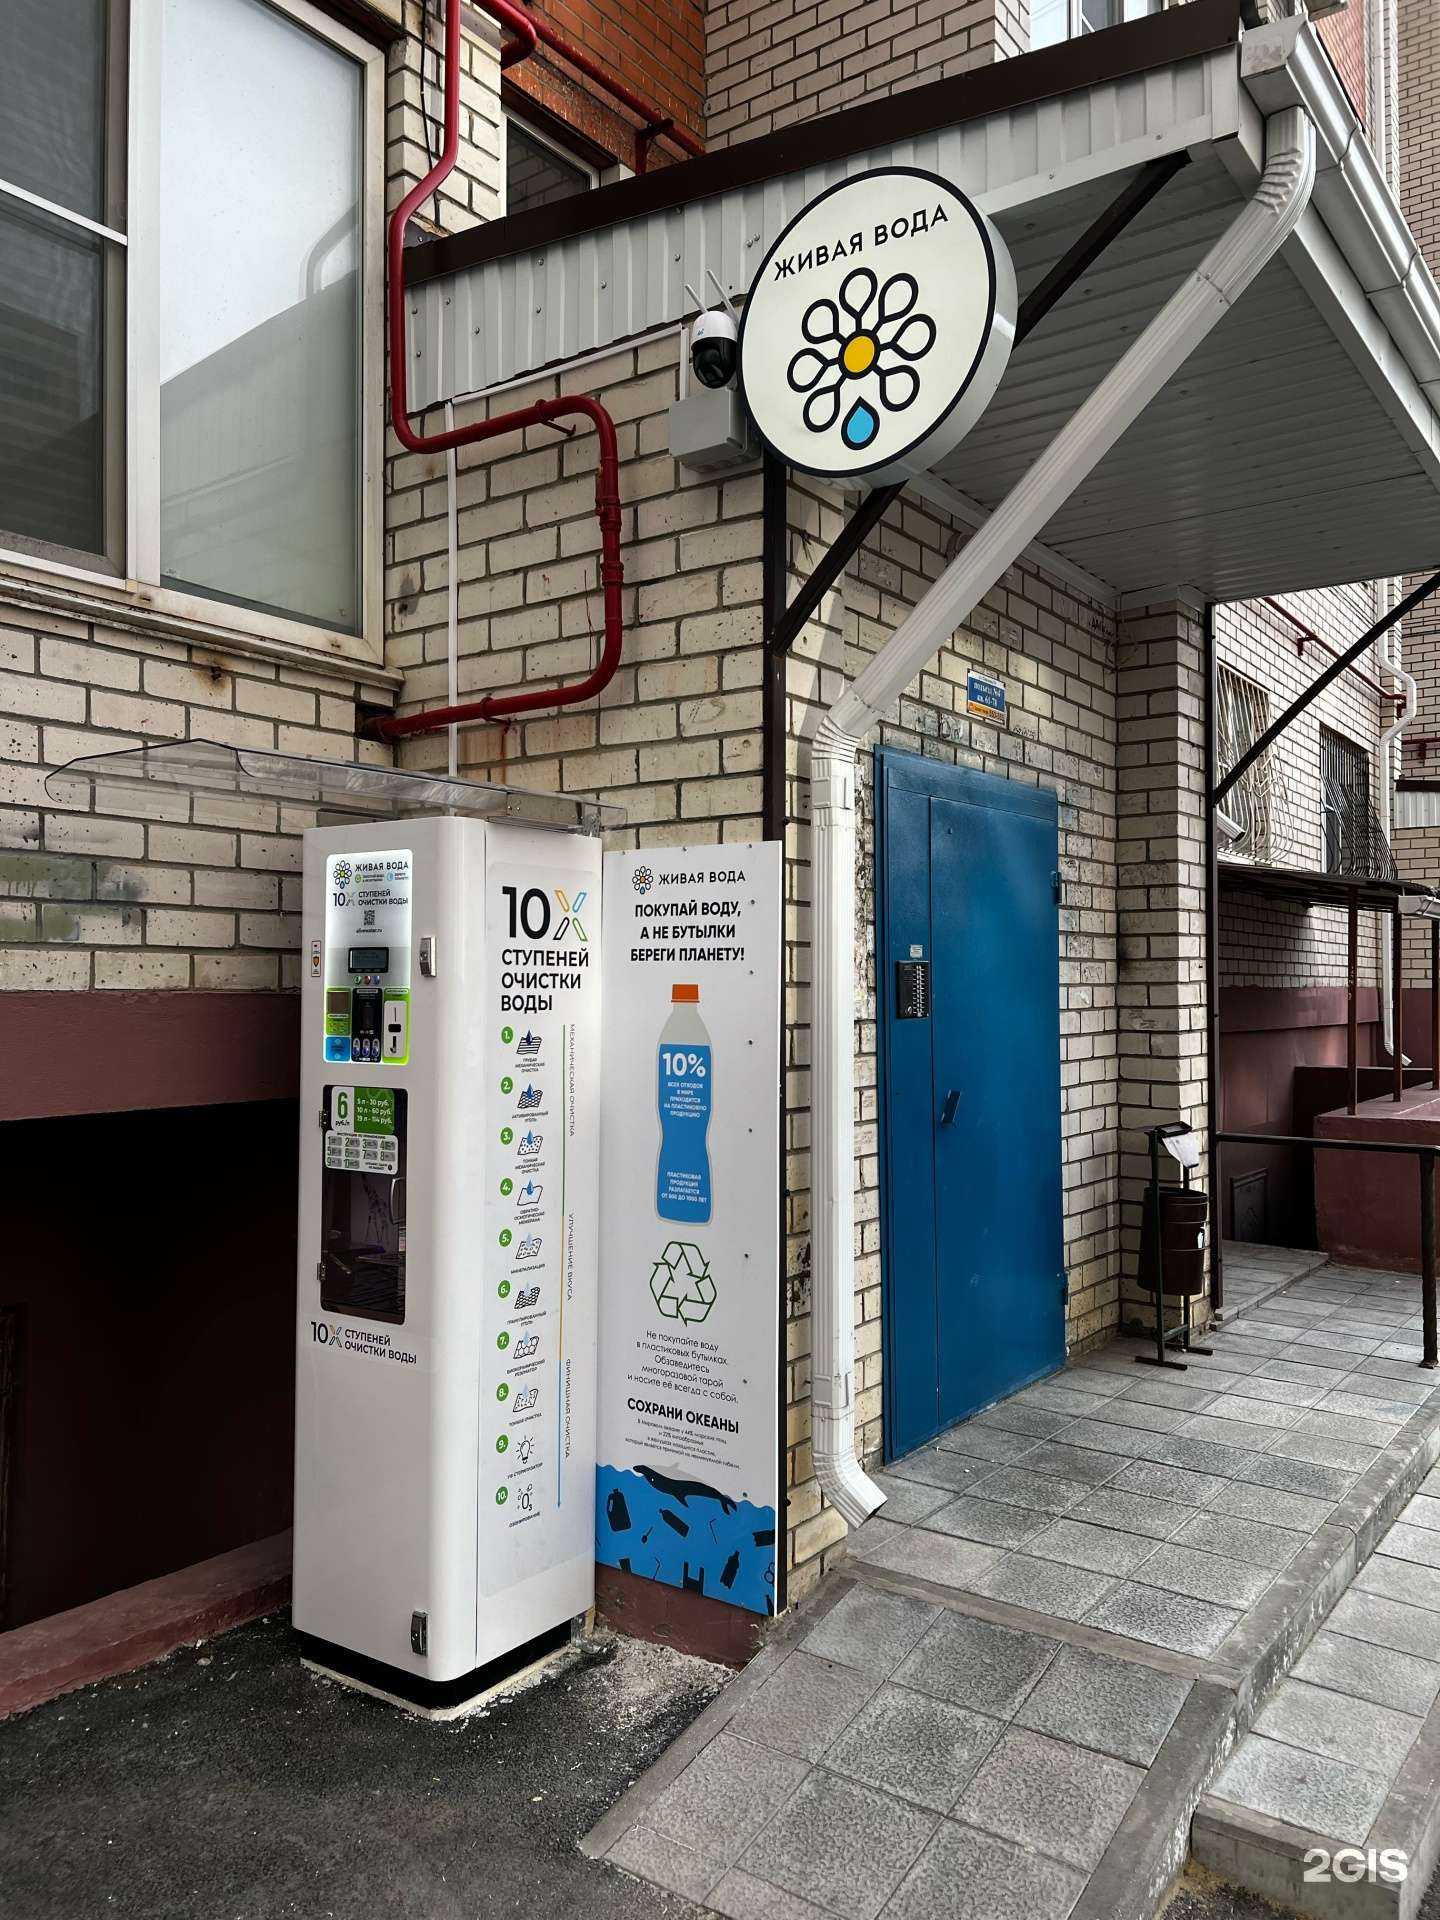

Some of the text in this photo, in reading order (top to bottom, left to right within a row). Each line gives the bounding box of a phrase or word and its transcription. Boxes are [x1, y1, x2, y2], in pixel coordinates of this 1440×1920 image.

[774, 204, 948, 281] ЖИВАЯ ВОДА
[355, 861, 409, 872] ЖИВАЯ ВОДА
[659, 870, 746, 885] ЖИВАЯ ВОДА
[358, 889, 391, 898] СТУПЕНЕЙ
[358, 897, 408, 906] ОЧИСТКИ ВОДЫ
[635, 899, 741, 917] ПОКУПАЙ ВОДУ,
[640, 924, 735, 939] А НЕ БУТЫЛКИ
[502, 947, 589, 967] СТУПЕНЕЙ
[631, 948, 744, 962] БЕРЕГИ ПЛАНЕТУ!
[501, 972, 581, 989] ОЧИСТКИ
[501, 994, 552, 1014] ВОДЫ
[662, 1053, 706, 1077] 10%
[337, 1092, 348, 1119] 6
[345, 1329, 391, 1347] СТУПЕНЕЙ
[646, 1331, 719, 1353] Не покупайте воду
[344, 1340, 417, 1364] ОЧИСТКИ ВОДЫ
[642, 1342, 690, 1357] пластиковых
[654, 1354, 710, 1374] Обзаведитесь
[634, 1375, 660, 1387] носите
[674, 1384, 701, 1395] всегда
[641, 1365, 724, 1389] многоразовой тарой
[627, 1398, 739, 1434] СОХРАНИ ОКЕАНЫ
[498, 1491, 506, 1499] 10.
